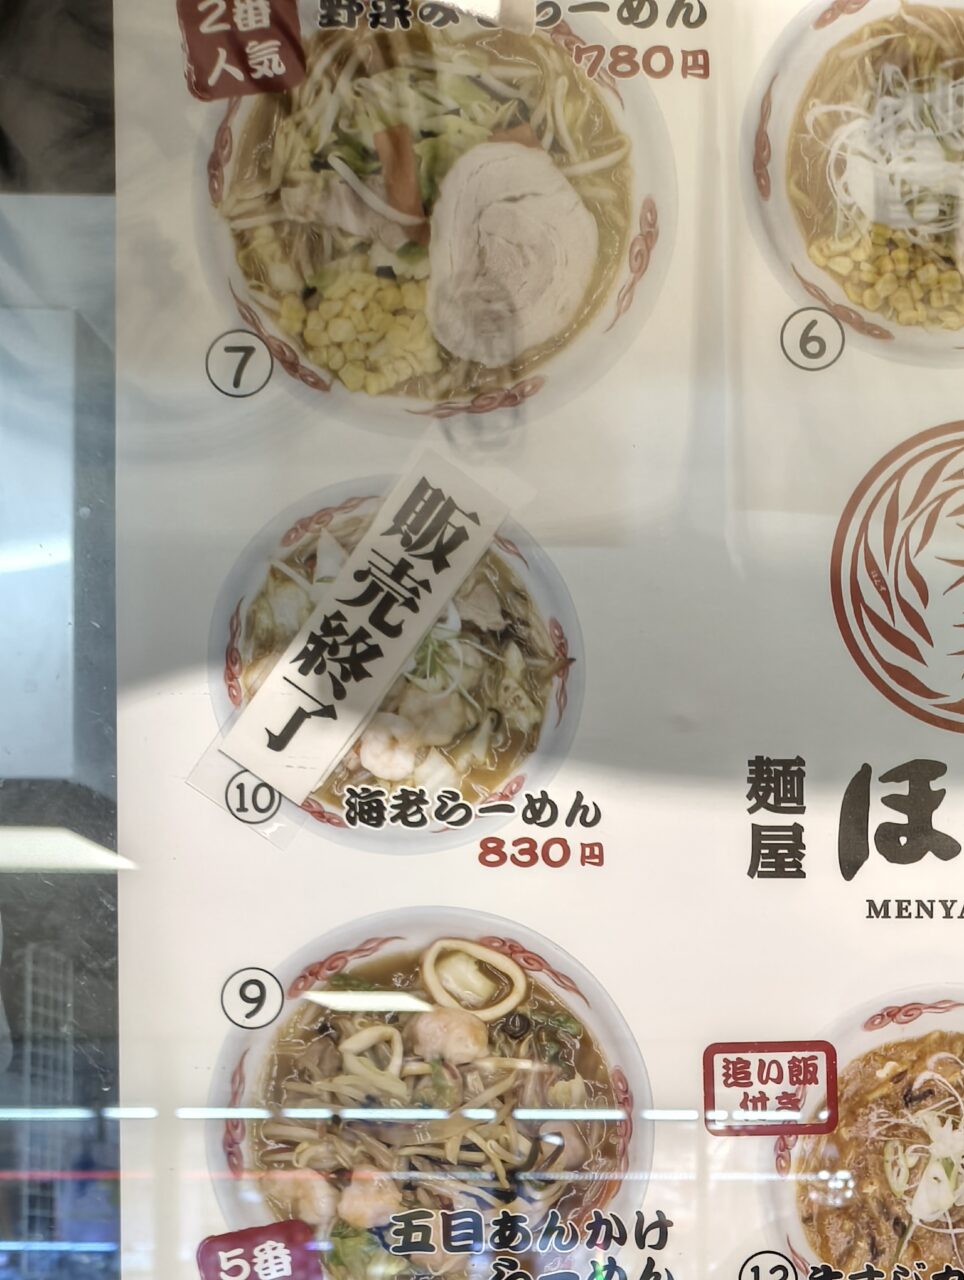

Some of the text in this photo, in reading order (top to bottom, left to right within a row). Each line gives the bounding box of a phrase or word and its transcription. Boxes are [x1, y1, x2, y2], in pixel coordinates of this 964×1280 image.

[207, 39, 286, 87] 人気
[572, 43, 711, 81] 780円
[265, 475, 481, 752] 販売終了
[343, 787, 603, 831] 海老らーめん
[745, 754, 807, 880] 麺屋
[477, 837, 605, 869] 830円
[721, 1055, 820, 1088] 追い飯
[388, 1208, 675, 1256] 五目あんかけ
